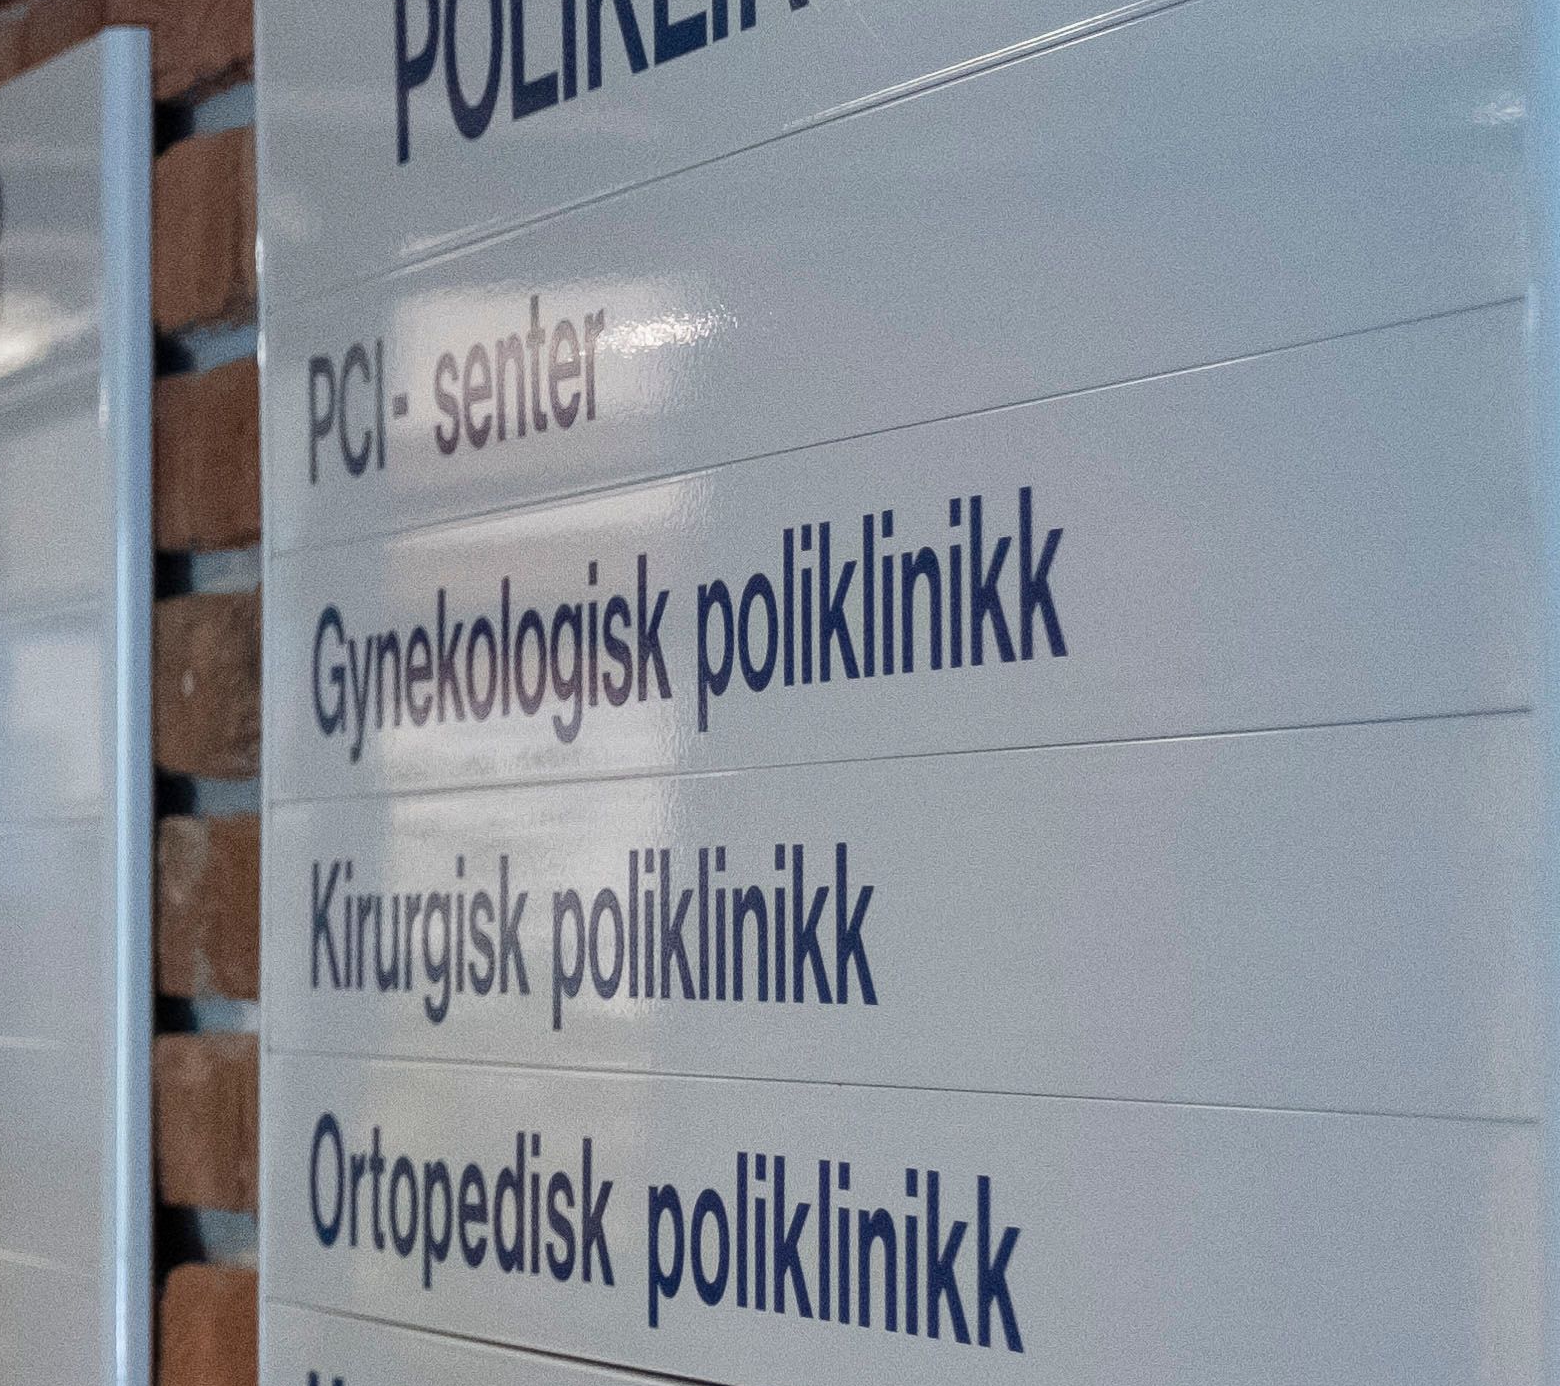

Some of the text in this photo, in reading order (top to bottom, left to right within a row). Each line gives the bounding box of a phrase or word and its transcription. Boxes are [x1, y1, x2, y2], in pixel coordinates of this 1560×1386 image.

[433, 294, 606, 455] senter
[311, 486, 1068, 763] Gynekologisk poliklinikk
[310, 842, 879, 1030] Kirurgisk poliklinikk
[308, 1112, 1025, 1354] Ortopedisk poliklinikk
